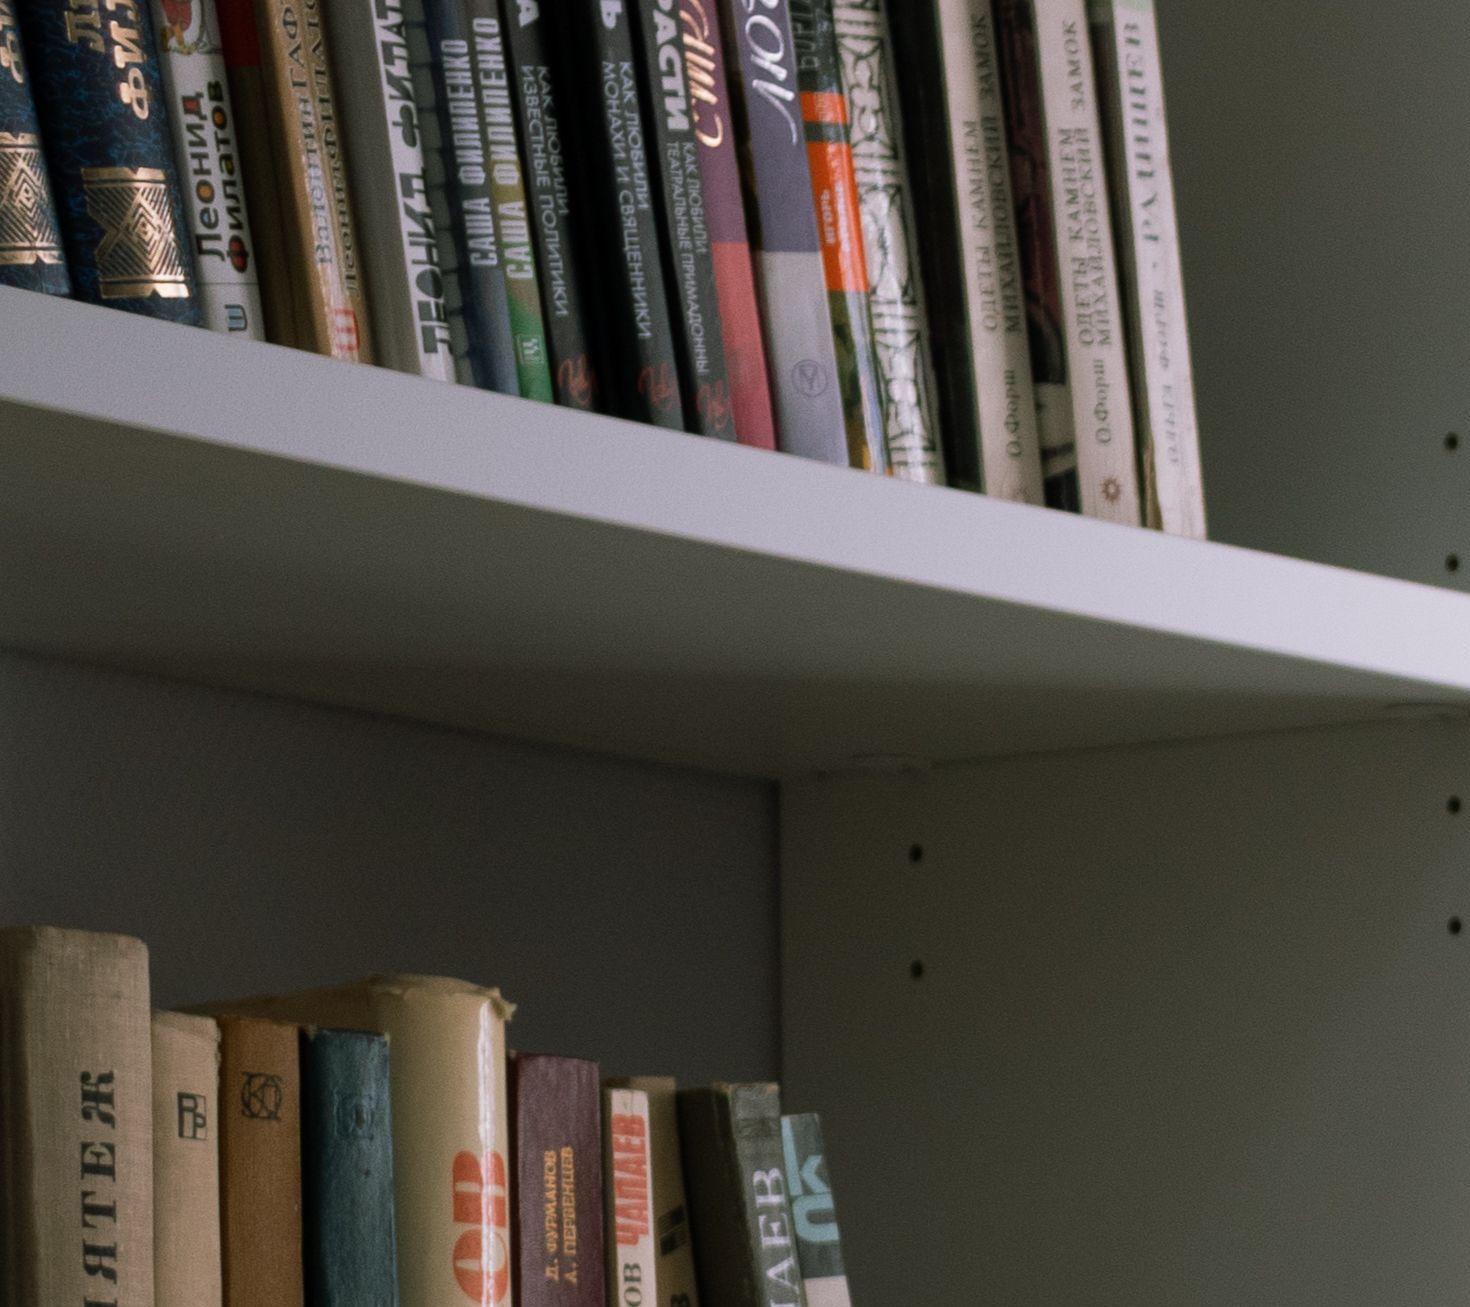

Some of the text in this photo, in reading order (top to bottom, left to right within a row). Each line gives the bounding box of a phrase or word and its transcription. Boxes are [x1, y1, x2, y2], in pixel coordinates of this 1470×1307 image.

[182, 92, 226, 261] Леонид
[207, 80, 249, 273] Филатов
[281, 0, 333, 266] Валентин ГАФ
[374, 0, 450, 354] ЛЕОНИД ФИЛАТ
[441, 39, 498, 266] САША ФИЛИПЕНКО
[473, 17, 533, 280] САША ФИЛИПЕНКО
[521, 64, 568, 317] ИЗВЕСТНЫЕ ПОЛИТИКИ
[535, 65, 569, 215] КАК ЛЮБИЛИ
[602, 61, 652, 339] МОНАХИ И СВЯЩЕННИКИ
[618, 61, 648, 210] КАК ЛЮБИЛИ
[681, 142, 707, 254] КАК ЛЮБИЛИ
[962, 120, 998, 331] ОДЕТЫ КАМНЕМ
[970, 12, 1022, 336] МИХАЙЛОВСКИЙ ЗАМОК
[1058, 127, 1094, 344] ОДЕТЫ КАМНЕМ
[1062, 20, 1112, 347] МИХАЙЛОВСКИЙ ЗАМОК
[1124, 22, 1160, 243] РАДИЩЕВ
[666, 141, 710, 374] ТЕАТРАЛЬНЫЕ ПРИМАДОННЫ
[543, 1150, 560, 1251] ФУРМАНОВ
[559, 1145, 581, 1258] ПЕРВЕНЦЕВ
[610, 1112, 650, 1247] ЧАПАЕВ
